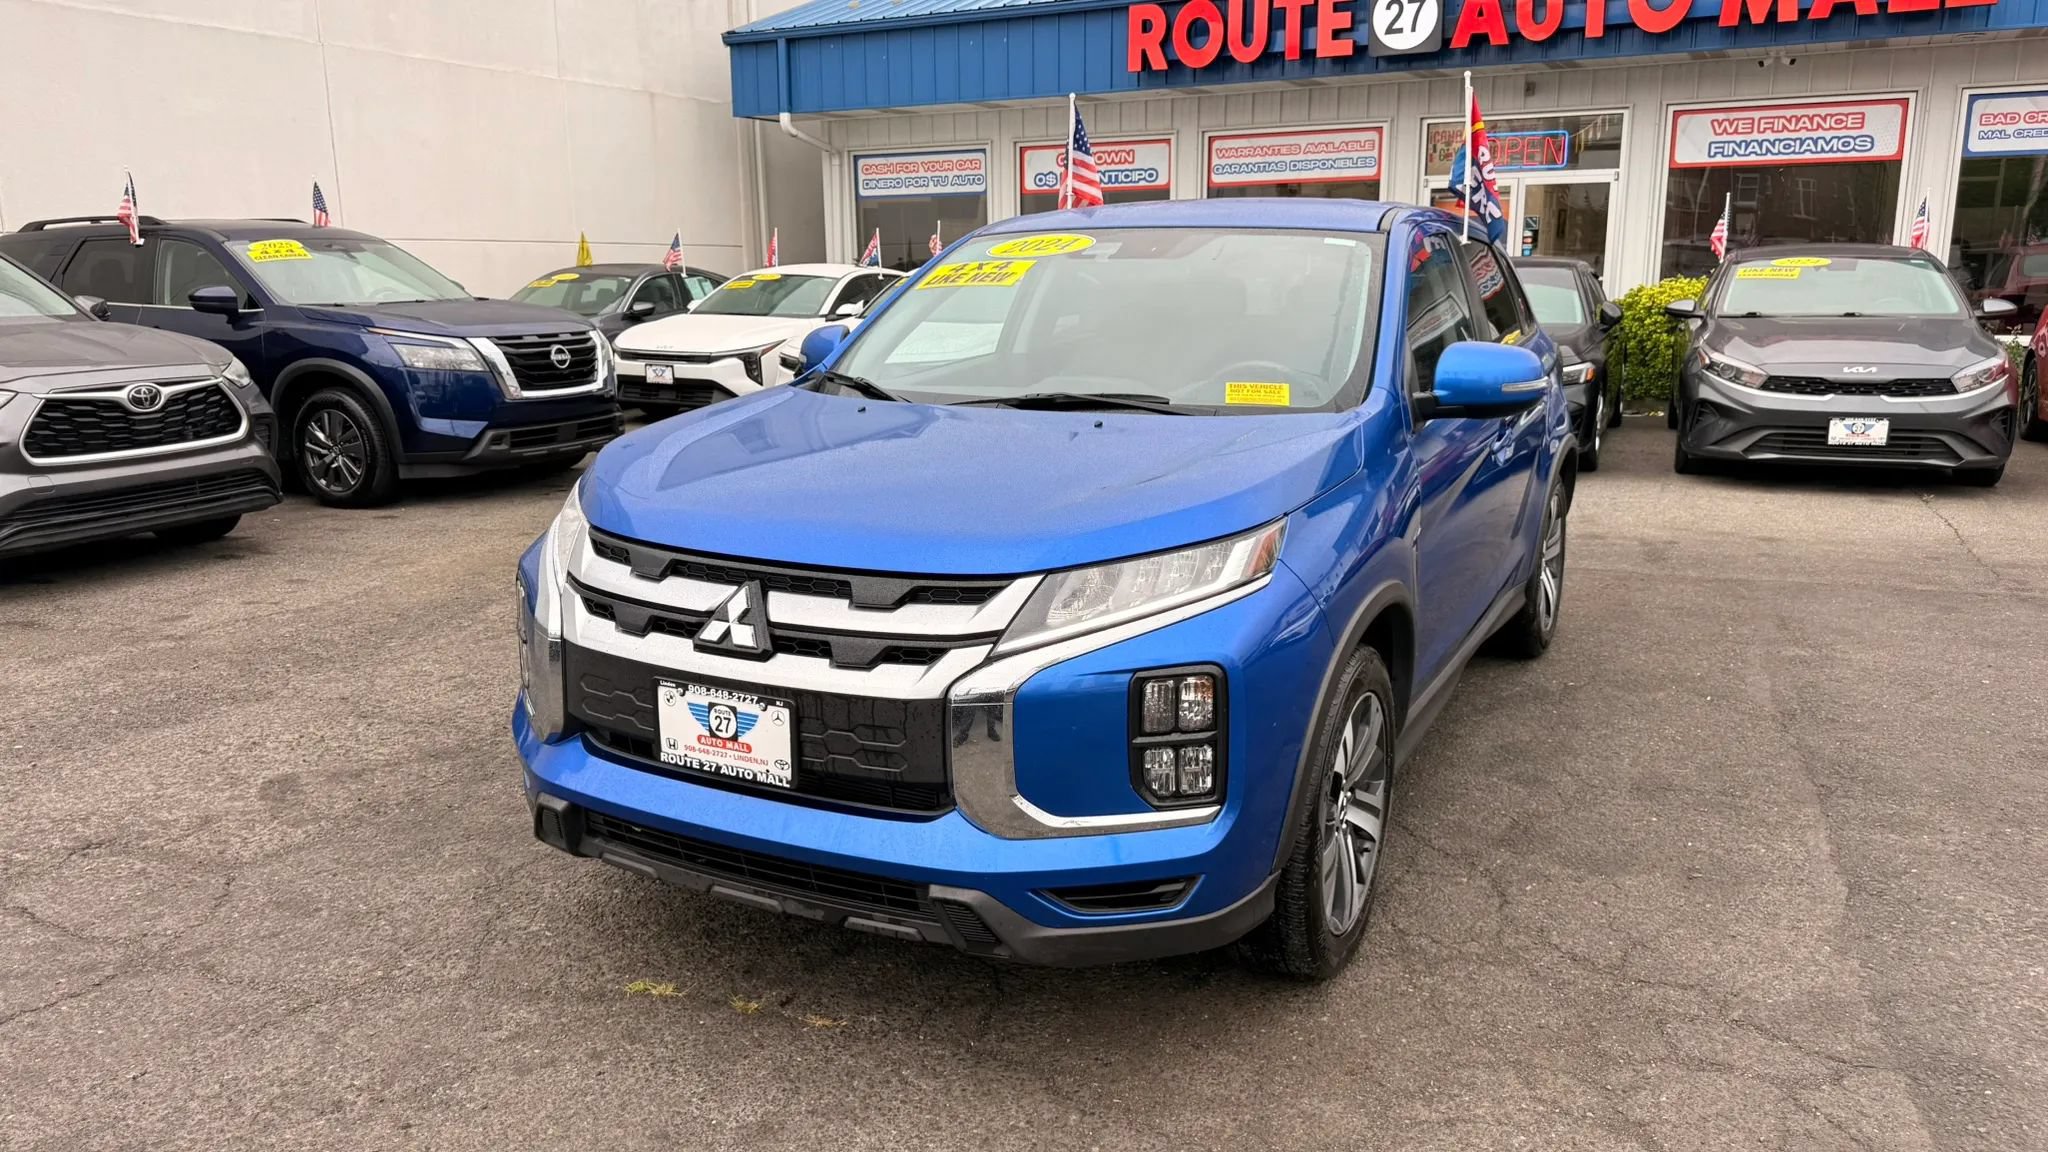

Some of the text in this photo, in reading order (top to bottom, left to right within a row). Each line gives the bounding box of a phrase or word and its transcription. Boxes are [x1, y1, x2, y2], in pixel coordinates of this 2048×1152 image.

[1127, 0, 1354, 72] ROUTE
[1384, 0, 1425, 36] 27
[1711, 112, 1865, 136] WE FINANCE
[1980, 112, 2020, 126] BAD
[1978, 130, 2011, 140] MAL
[1216, 140, 1376, 159] WARRANTIES AVAILABLE
[1708, 135, 1874, 158] FINANCIAMOS
[1092, 149, 1135, 166] OWN
[1213, 156, 1376, 176] GARANTIAS DISPONIBLES
[862, 159, 982, 176] CASH FOR YOUR CAR
[862, 174, 986, 190] DINERO POR TU AUTO
[1096, 168, 1159, 185] NTICIPO
[1000, 238, 1081, 254] 2024
[922, 272, 1016, 287] LIKE NEW
[688, 684, 758, 704] 908-648-2727
[713, 708, 732, 716] ROUTE
[714, 715, 732, 734] 27
[684, 744, 729, 758] 908-648-2727
[700, 736, 748, 752] AUTO MALL
[660, 753, 790, 788] ROUTE 27 AUTO MALL
